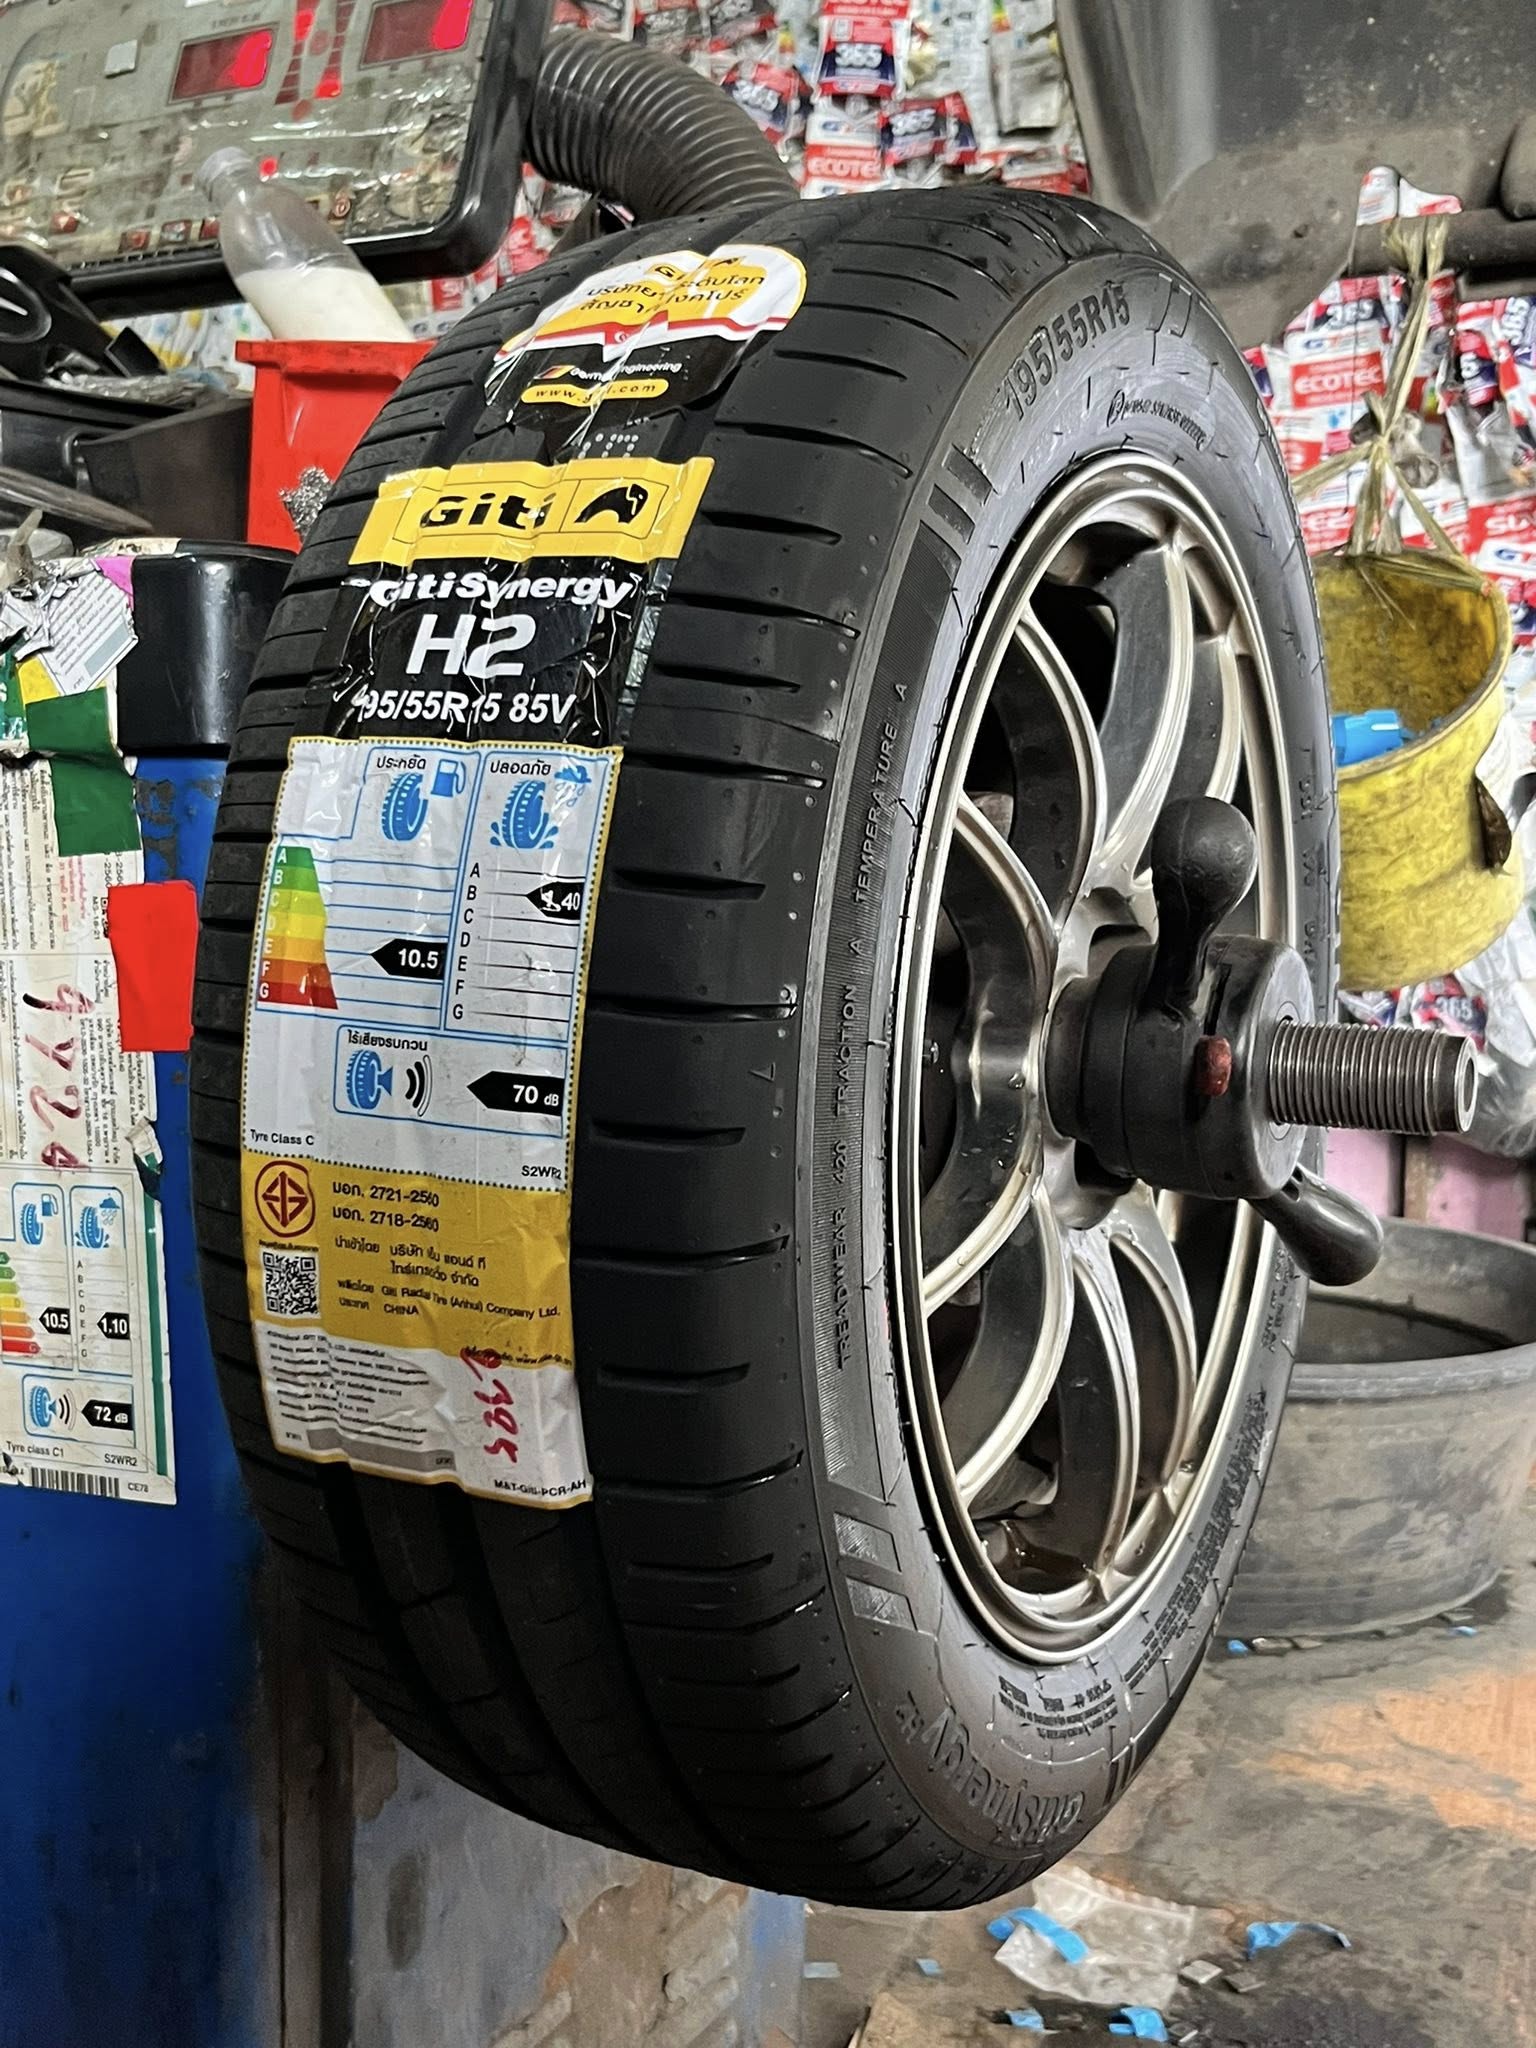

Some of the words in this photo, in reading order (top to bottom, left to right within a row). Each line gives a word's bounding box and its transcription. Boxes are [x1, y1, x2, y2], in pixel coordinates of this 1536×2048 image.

[834, 43, 883, 68] 365
[1294, 365, 1383, 394] ECOTEC
[420, 492, 557, 530] Giti
[369, 570, 634, 609] GitiSynergy
[405, 613, 537, 680] H2
[894, 682, 908, 700] A
[508, 692, 577, 724] 85V
[489, 759, 551, 776] ปลอดภัย
[855, 723, 898, 904] TEMPERATURE
[277, 848, 287, 864] A
[273, 870, 284, 885] B
[469, 862, 480, 878] A
[270, 892, 280, 907] C
[466, 885, 477, 901] B
[464, 908, 474, 924] C
[263, 939, 273, 953] E
[460, 932, 471, 947] D
[848, 936, 863, 956] A
[398, 948, 439, 969] 10.5
[458, 956, 468, 971] E
[261, 961, 271, 976] F
[259, 983, 269, 998] G
[455, 979, 465, 995] F
[452, 1003, 463, 1019] G
[836, 984, 858, 1116] TRACTION
[512, 1084, 539, 1104] 70
[543, 1093, 560, 1107] dB
[250, 1129, 269, 1145] Tyre
[271, 1133, 302, 1146] Class
[332, 1181, 365, 1198] มอก.
[332, 1206, 365, 1222] มอก.
[77, 1260, 83, 1269] A
[77, 1275, 84, 1283] B
[78, 1289, 85, 1298] C
[834, 1206, 851, 1371] TREADWEAR
[79, 1304, 86, 1313] D
[383, 1303, 419, 1315] CHINA
[486, 1302, 535, 1320] Company
[539, 1306, 560, 1318] Ltd.
[43, 1312, 69, 1329] 10.5
[80, 1320, 86, 1328] E
[101, 1317, 128, 1335] 1.10
[81, 1335, 87, 1343] F
[81, 1349, 88, 1358] G
[94, 1405, 112, 1422] 72
[115, 1412, 128, 1424] dB
[6, 1441, 25, 1453] Tyre
[27, 1443, 50, 1456] class
[52, 1447, 64, 1457] C1
[104, 1453, 138, 1467] S2WR2
